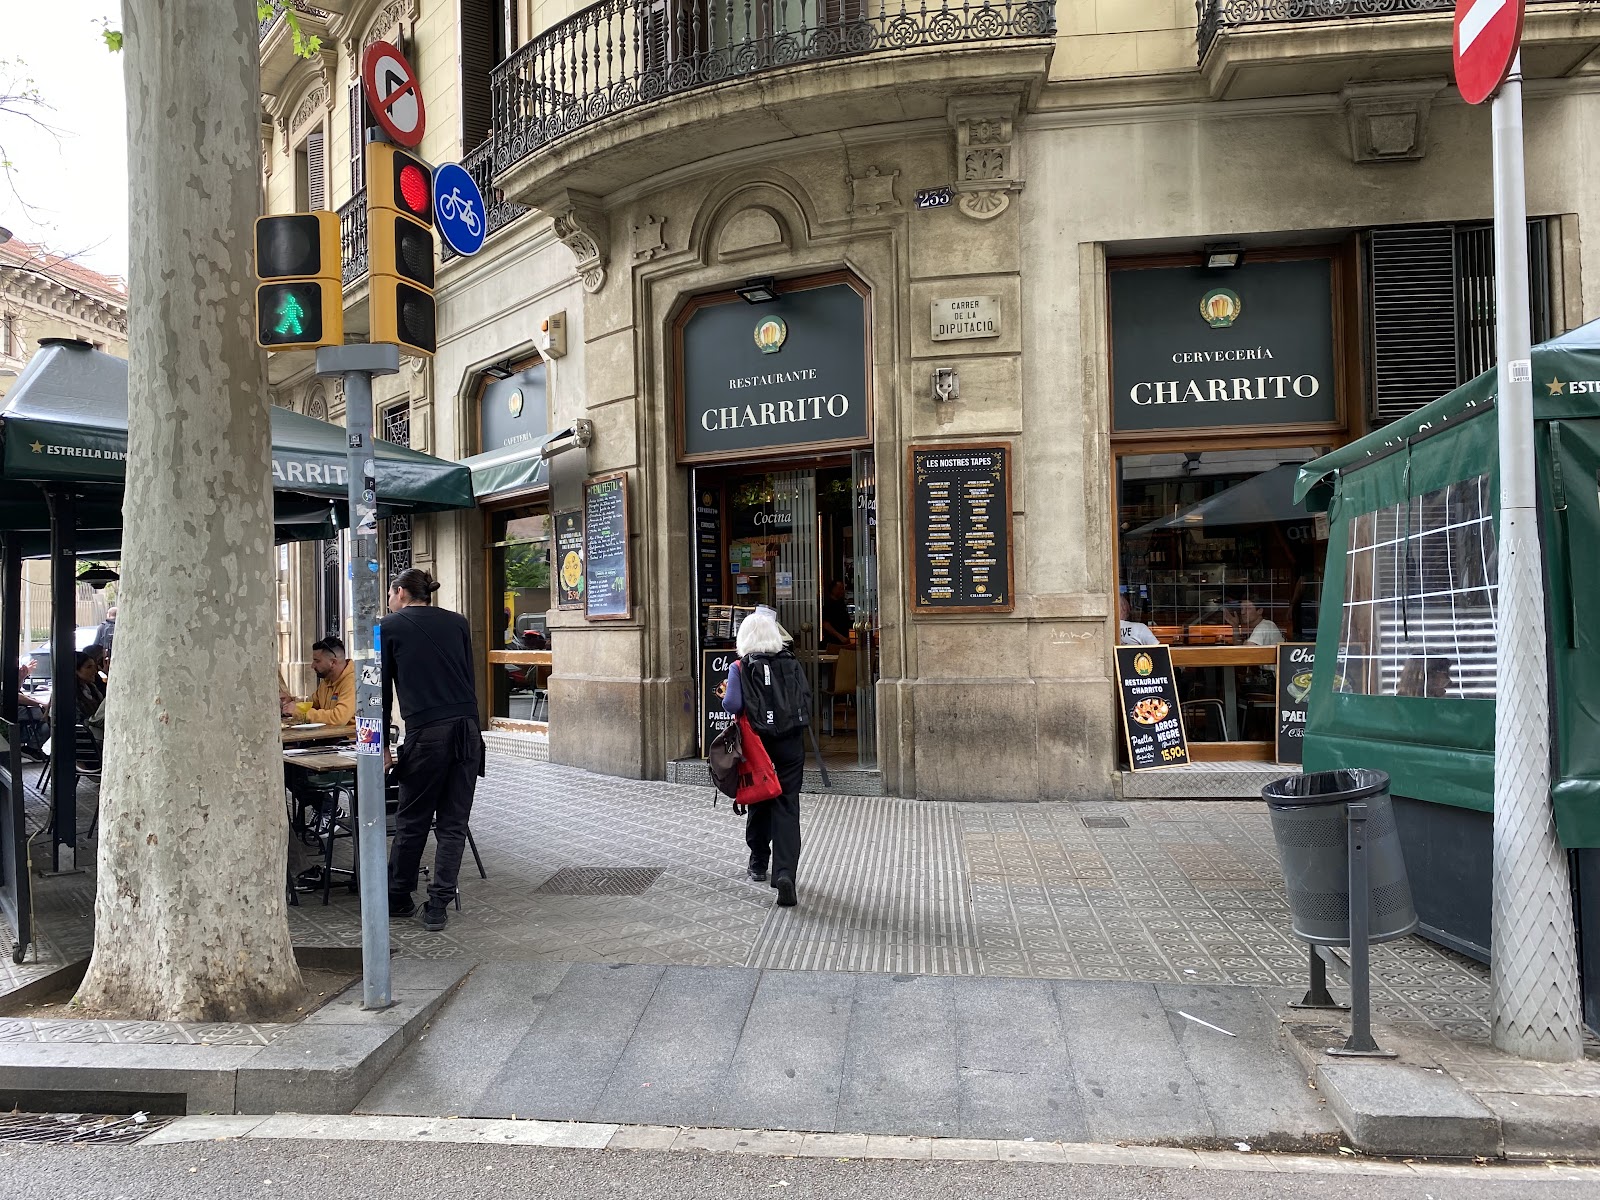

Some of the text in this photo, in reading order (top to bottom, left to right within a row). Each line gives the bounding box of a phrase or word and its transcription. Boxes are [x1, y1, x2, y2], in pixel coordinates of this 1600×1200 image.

[951, 299, 980, 311] CARRER
[954, 311, 977, 321] DE LA
[939, 317, 994, 335] DIPUTACIÓ
[1172, 346, 1274, 365] CERVECERÍA
[728, 368, 817, 390] RESTAURANTE
[1129, 373, 1320, 406] CHARRITO
[701, 393, 850, 432] CHARRITO
[503, 431, 533, 447] CAFETERÍA
[46, 445, 102, 459] ESTRELLA
[926, 456, 992, 468] LES NOSTRES TAPES
[753, 510, 792, 526] Cocina
[1125, 676, 1169, 687] RESTAURANTE
[1131, 686, 1164, 695] CHARRITO
[1154, 718, 1178, 732] ARROS
[1130, 733, 1154, 747] Paella
[1156, 728, 1181, 742] NEGRE
[1160, 746, 1185, 762] 15,90€
